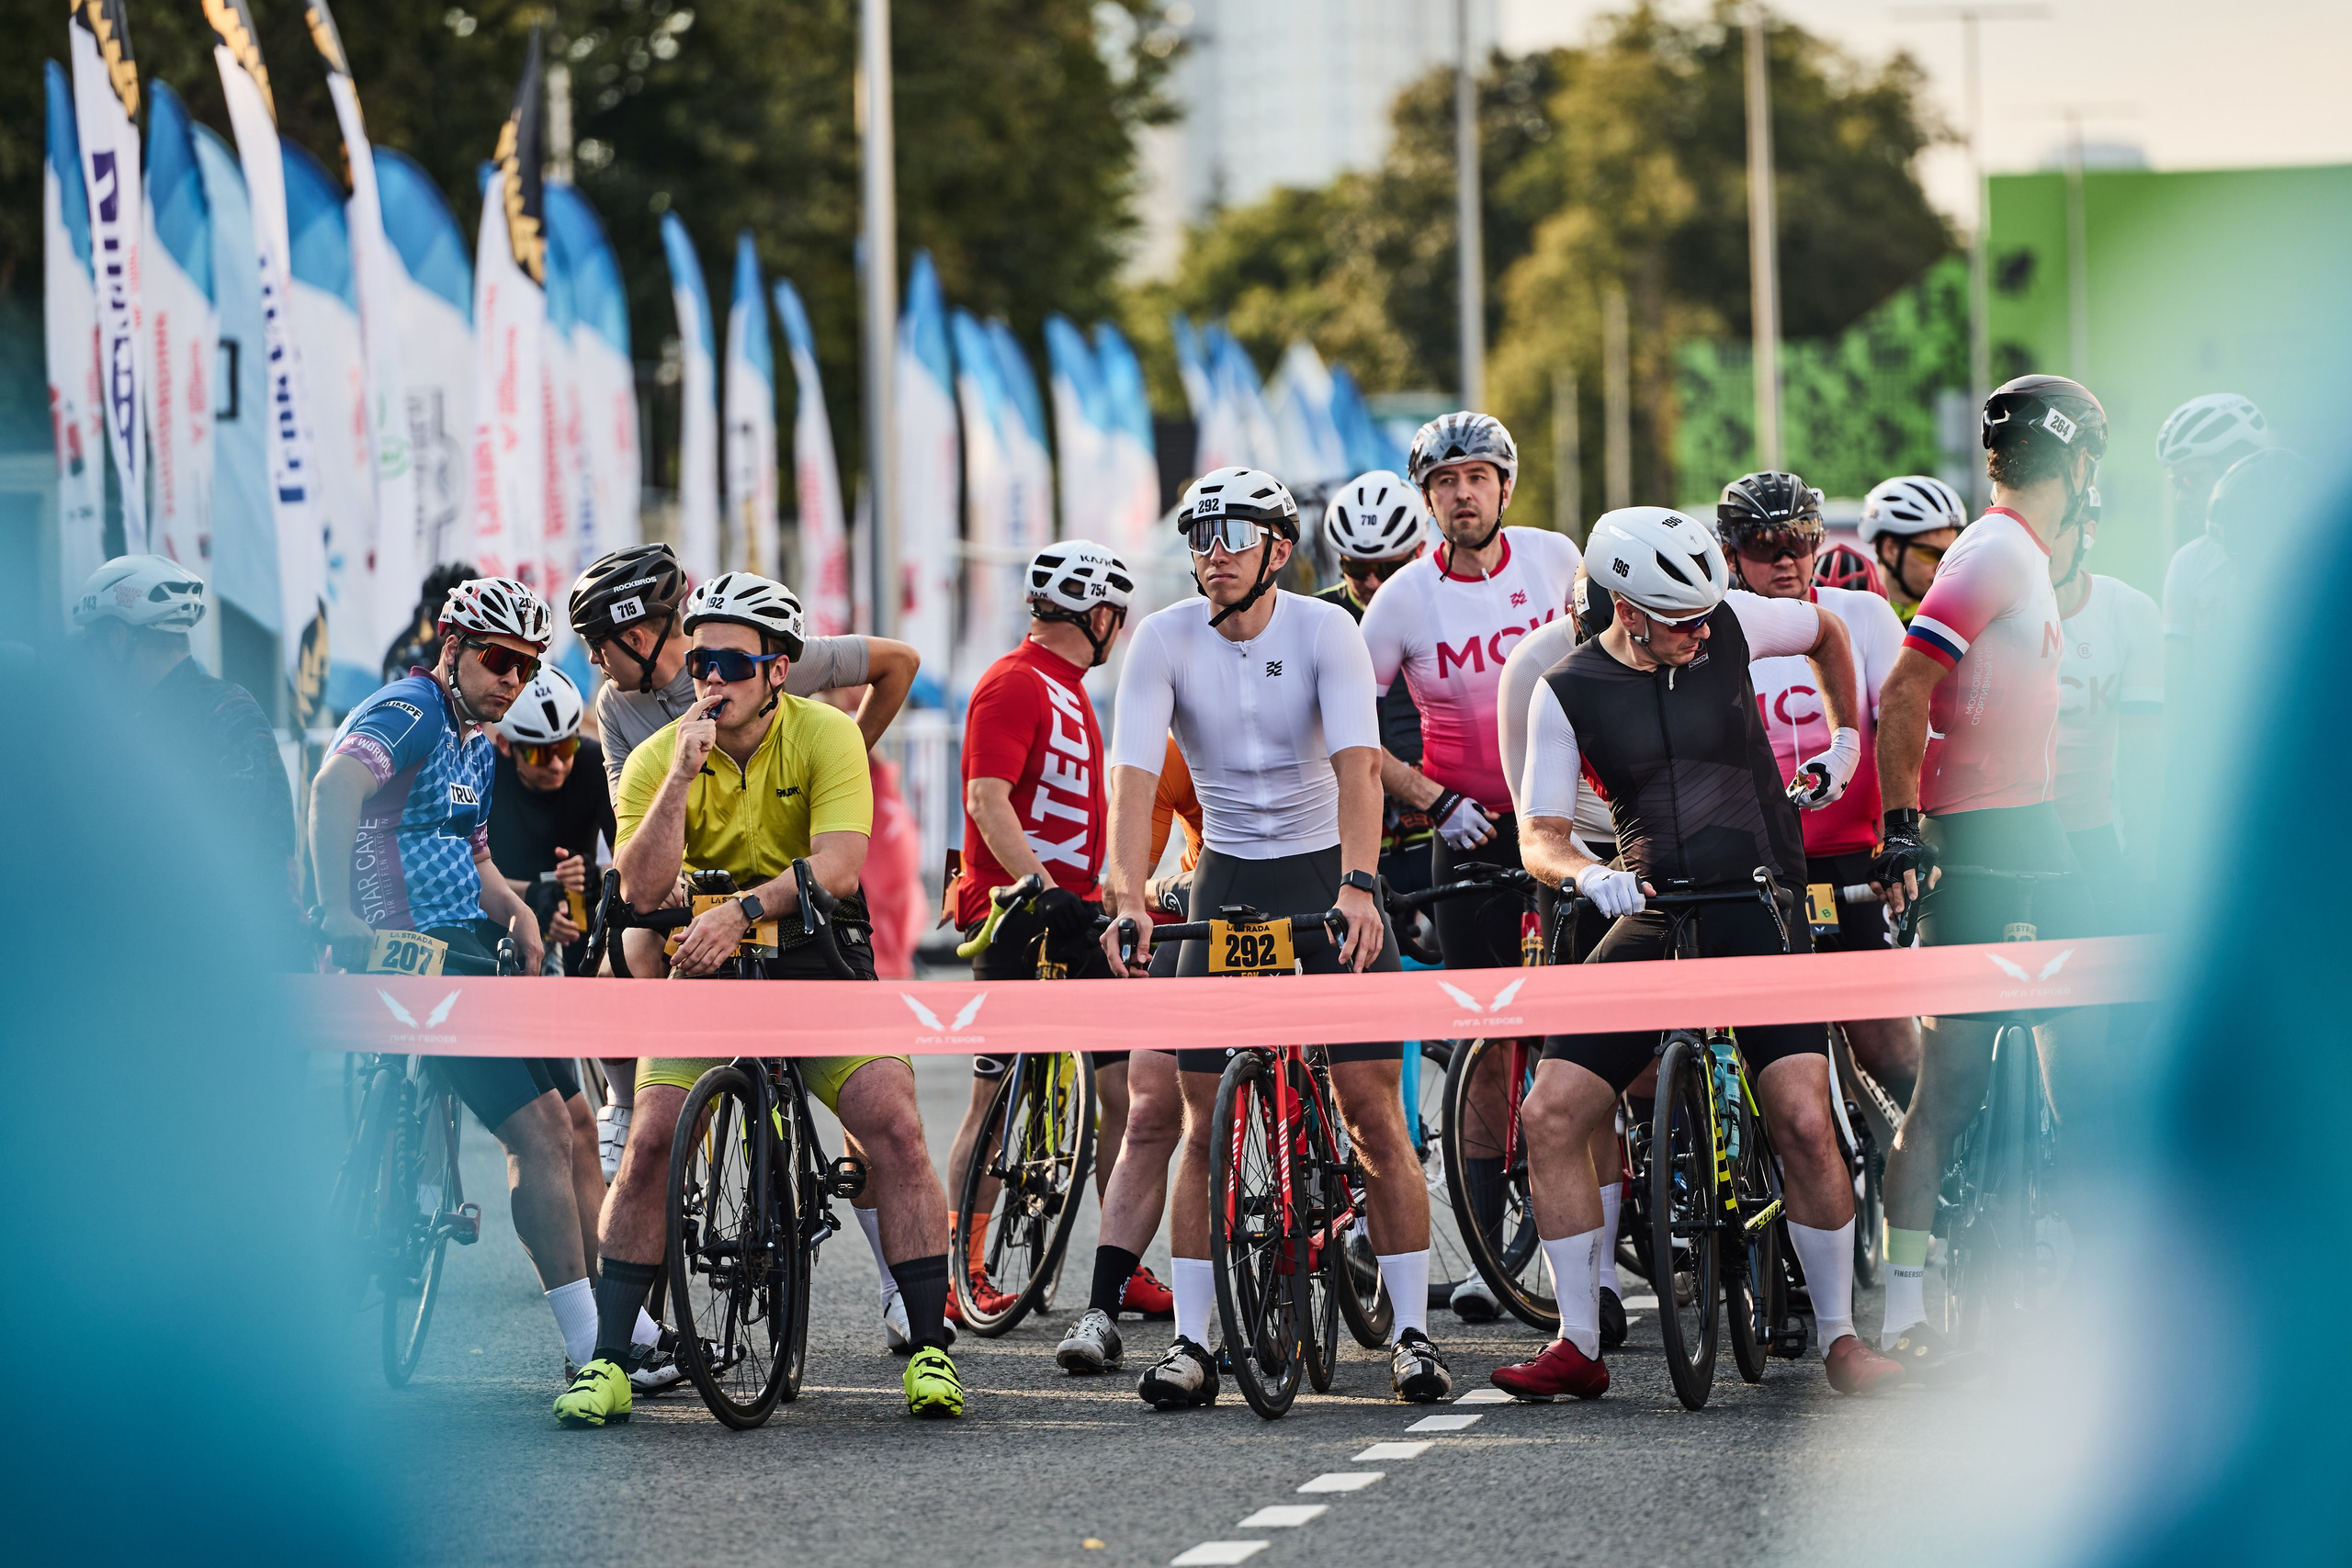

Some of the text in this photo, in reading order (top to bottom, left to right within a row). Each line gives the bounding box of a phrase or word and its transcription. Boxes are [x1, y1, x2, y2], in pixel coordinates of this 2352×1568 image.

[2050, 415, 2071, 437] 264
[1198, 498, 1219, 513] 292
[1361, 514, 1377, 525] 710
[1662, 516, 1682, 528] 196
[1080, 555, 1112, 568] KASK
[1612, 557, 1630, 578] 196
[613, 576, 657, 593] ROCKBROS
[1091, 582, 1106, 597] 754
[616, 601, 637, 619] 715
[706, 597, 724, 610] 192
[356, 873, 386, 924] STAR
[1822, 908, 1831, 918] B
[401, 933, 433, 945] STRADA
[1226, 933, 1277, 967] 292
[382, 940, 435, 976] 207
[2000, 987, 2072, 998] ЛИГА ГЕРОЕВ
[1453, 1016, 1523, 1027] ЛИГА ГЕРОЕВ
[390, 1034, 458, 1043] ЛИГА ГЕРОЕВ
[945, 1035, 985, 1043] ГЕРОЕВ
[1278, 1118, 1291, 1193] CANYON
[1758, 1201, 1783, 1230] SCOTT
